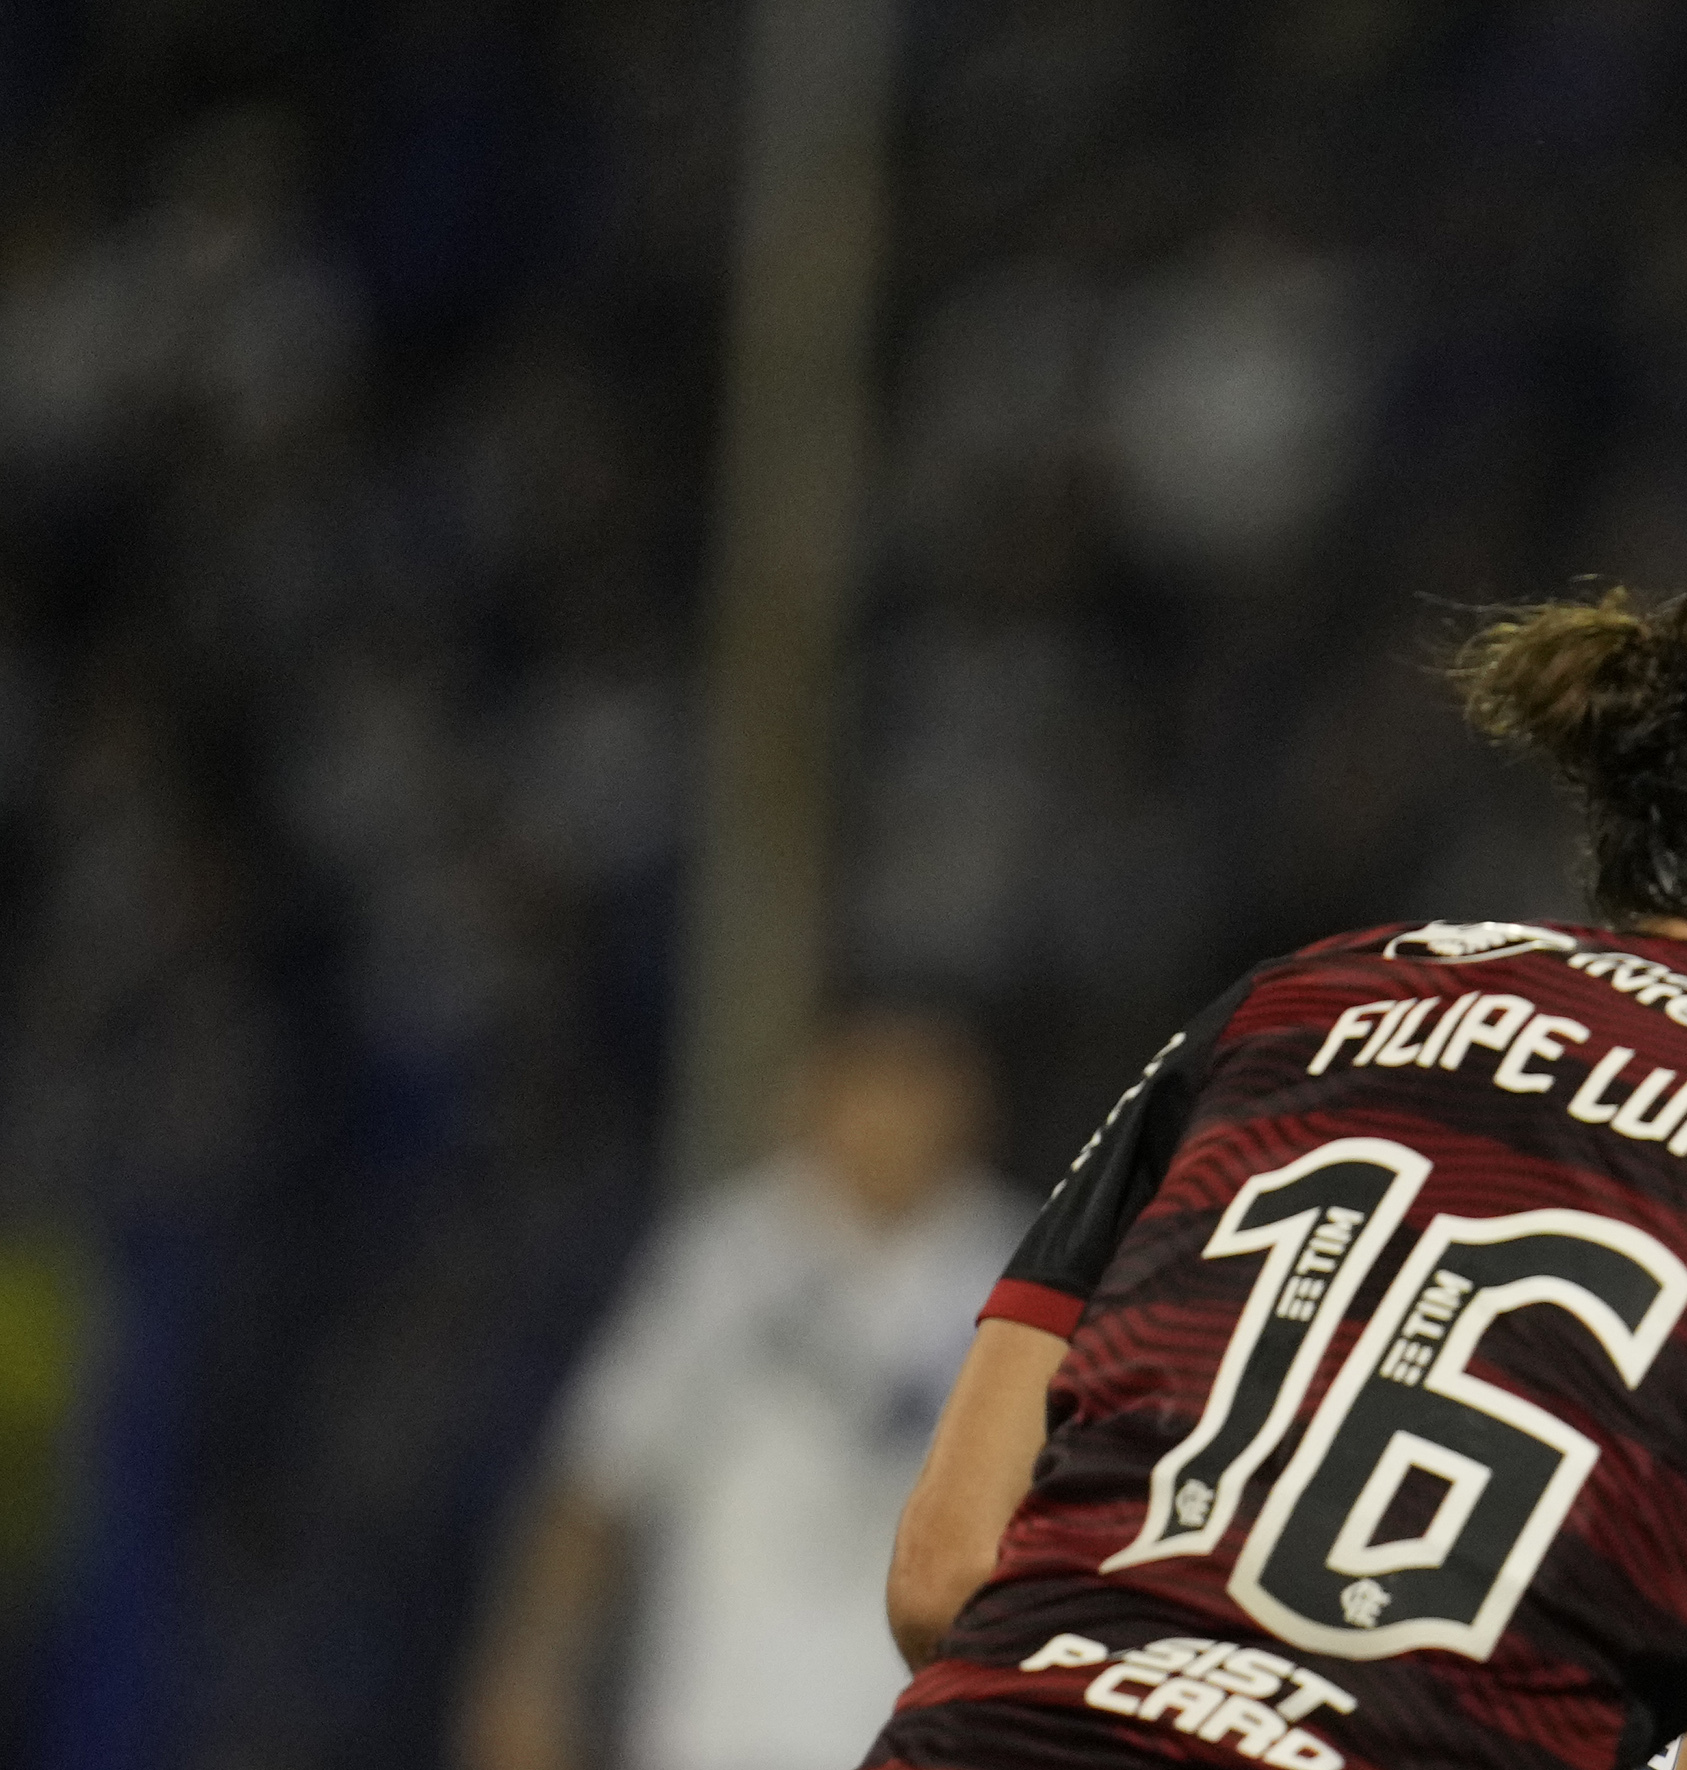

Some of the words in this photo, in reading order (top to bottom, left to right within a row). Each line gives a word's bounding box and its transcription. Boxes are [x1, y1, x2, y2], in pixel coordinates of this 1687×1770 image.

[1307, 990, 1591, 1093] FILIPE
[1295, 1205, 1365, 1276] TIM
[1402, 1268, 1474, 1341] TIM
